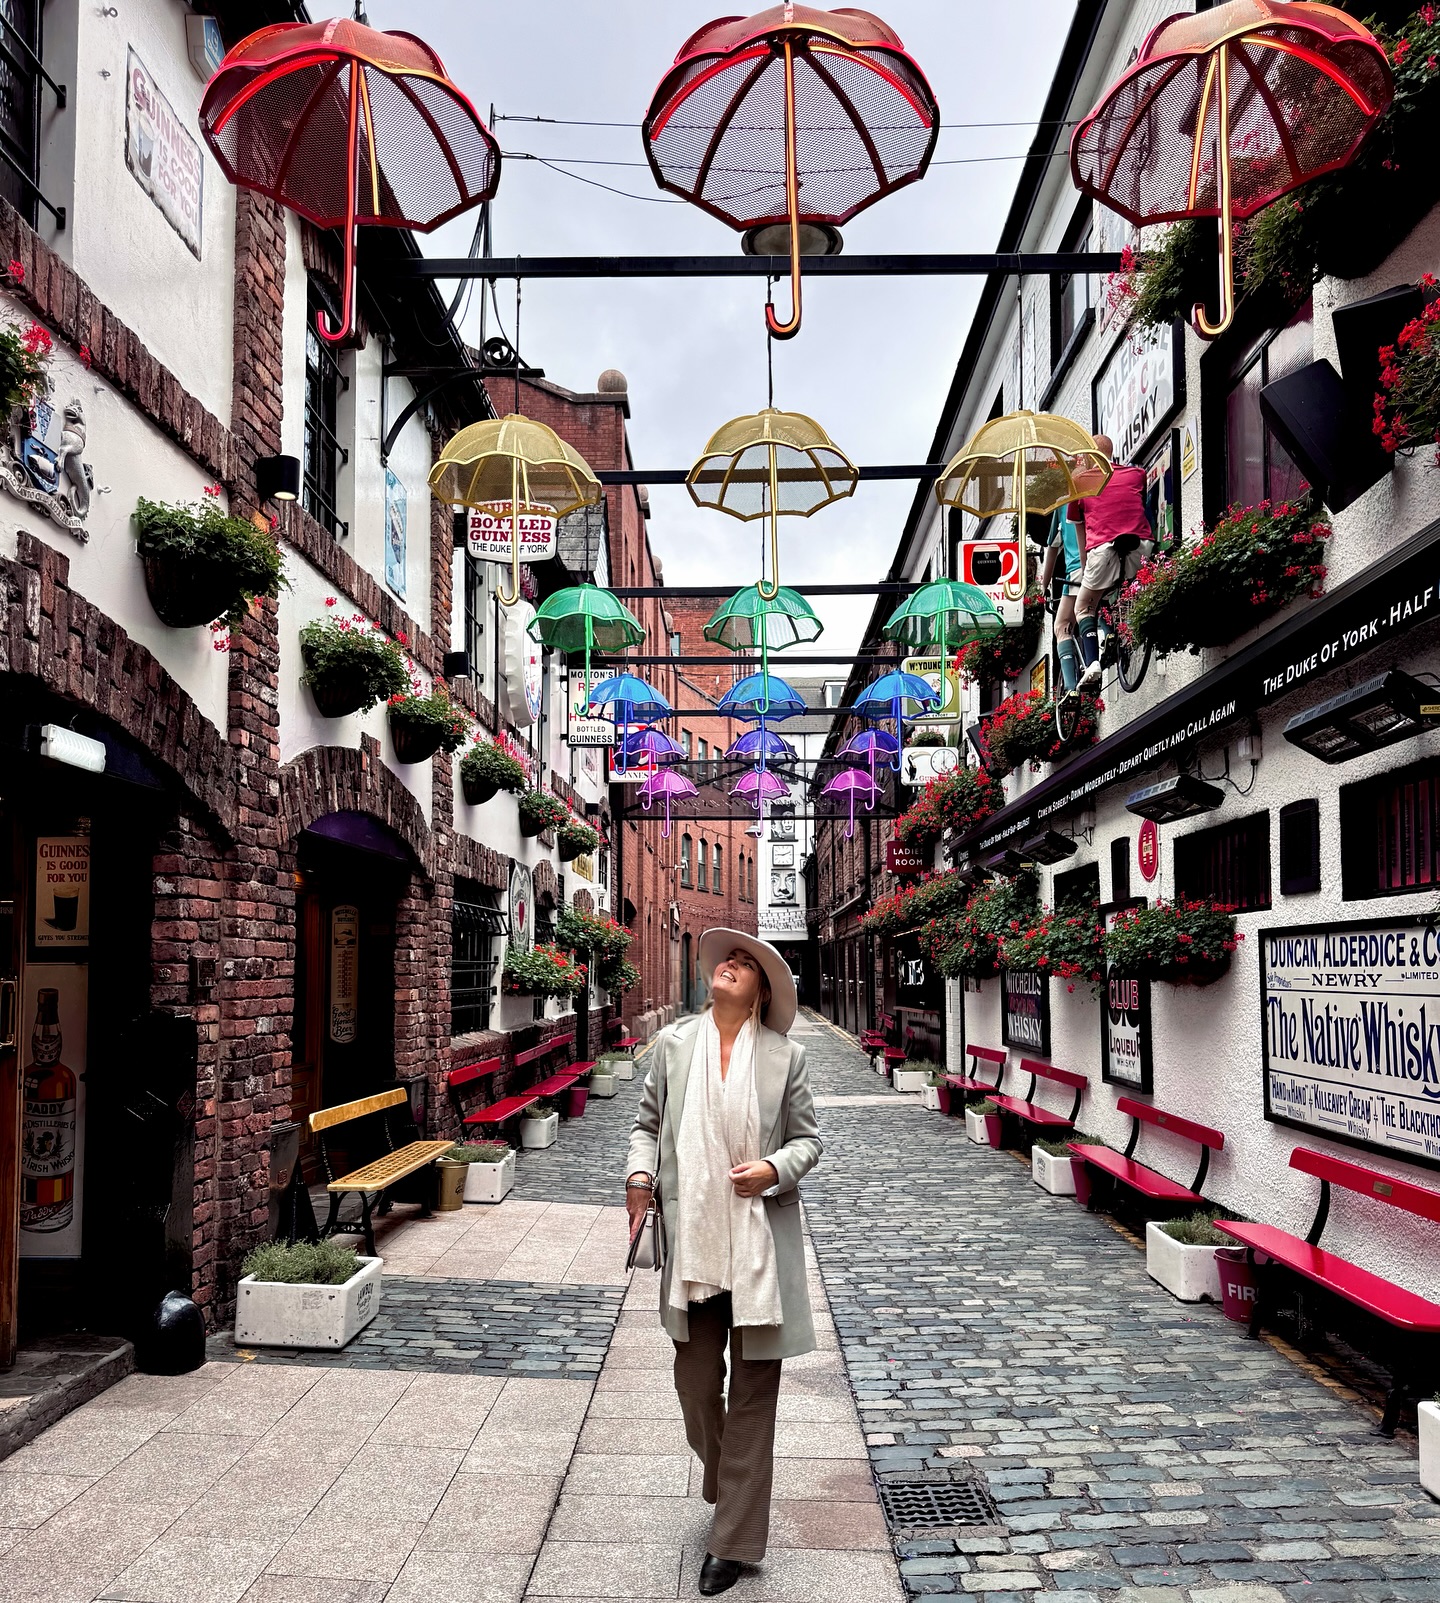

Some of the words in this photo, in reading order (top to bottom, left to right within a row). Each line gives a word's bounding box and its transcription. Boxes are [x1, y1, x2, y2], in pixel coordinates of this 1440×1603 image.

[133, 68, 200, 186] GUINNESS
[159, 138, 167, 163] IS
[158, 163, 176, 200] FOR
[179, 191, 198, 228] YOU
[1114, 386, 1158, 464] HISKY
[472, 542, 487, 552] THE
[490, 544, 512, 554] DUKE
[527, 544, 548, 554] YORK
[1262, 672, 1284, 696] THE
[1286, 652, 1318, 684] DUKE
[1320, 640, 1339, 663] OF
[1342, 617, 1379, 652] YORK
[1389, 586, 1434, 627] HALF
[570, 735, 613, 744] GUINNESS
[1052, 796, 1069, 811] SOBERLY
[1070, 785, 1085, 801] DRINK
[1084, 770, 1117, 793] MODERATELY
[1119, 752, 1143, 775] DEPART
[1143, 739, 1170, 761] QUIETLY
[1170, 729, 1186, 747] AND
[1186, 716, 1208, 737] CALL
[1208, 700, 1236, 726] AGAIN
[40, 843, 90, 858] GUINNES
[893, 847, 923, 855] LADIES
[46, 861, 56, 870] IS
[59, 860, 88, 870] GOOD
[895, 858, 923, 866] ROOM
[46, 873, 65, 883] FOR
[68, 873, 87, 883] YOU
[1270, 936, 1321, 970] DUNCAN,
[1323, 932, 1406, 967] ALDERDICE
[1409, 937, 1421, 967] &
[1311, 973, 1383, 987] NEWRY
[1405, 971, 1439, 980] LIMITED
[1108, 979, 1140, 1011] CLUB
[1007, 1012, 1042, 1042] WHISKY
[1269, 996, 1299, 1061] The
[1301, 997, 1362, 1071] Native
[1116, 1057, 1136, 1069] WHISKY
[26, 1102, 65, 1115] PADDY
[27, 1119, 69, 1129] DISTILLERIES
[27, 1157, 49, 1173] IRISH
[1227, 1282, 1259, 1302] FIR
